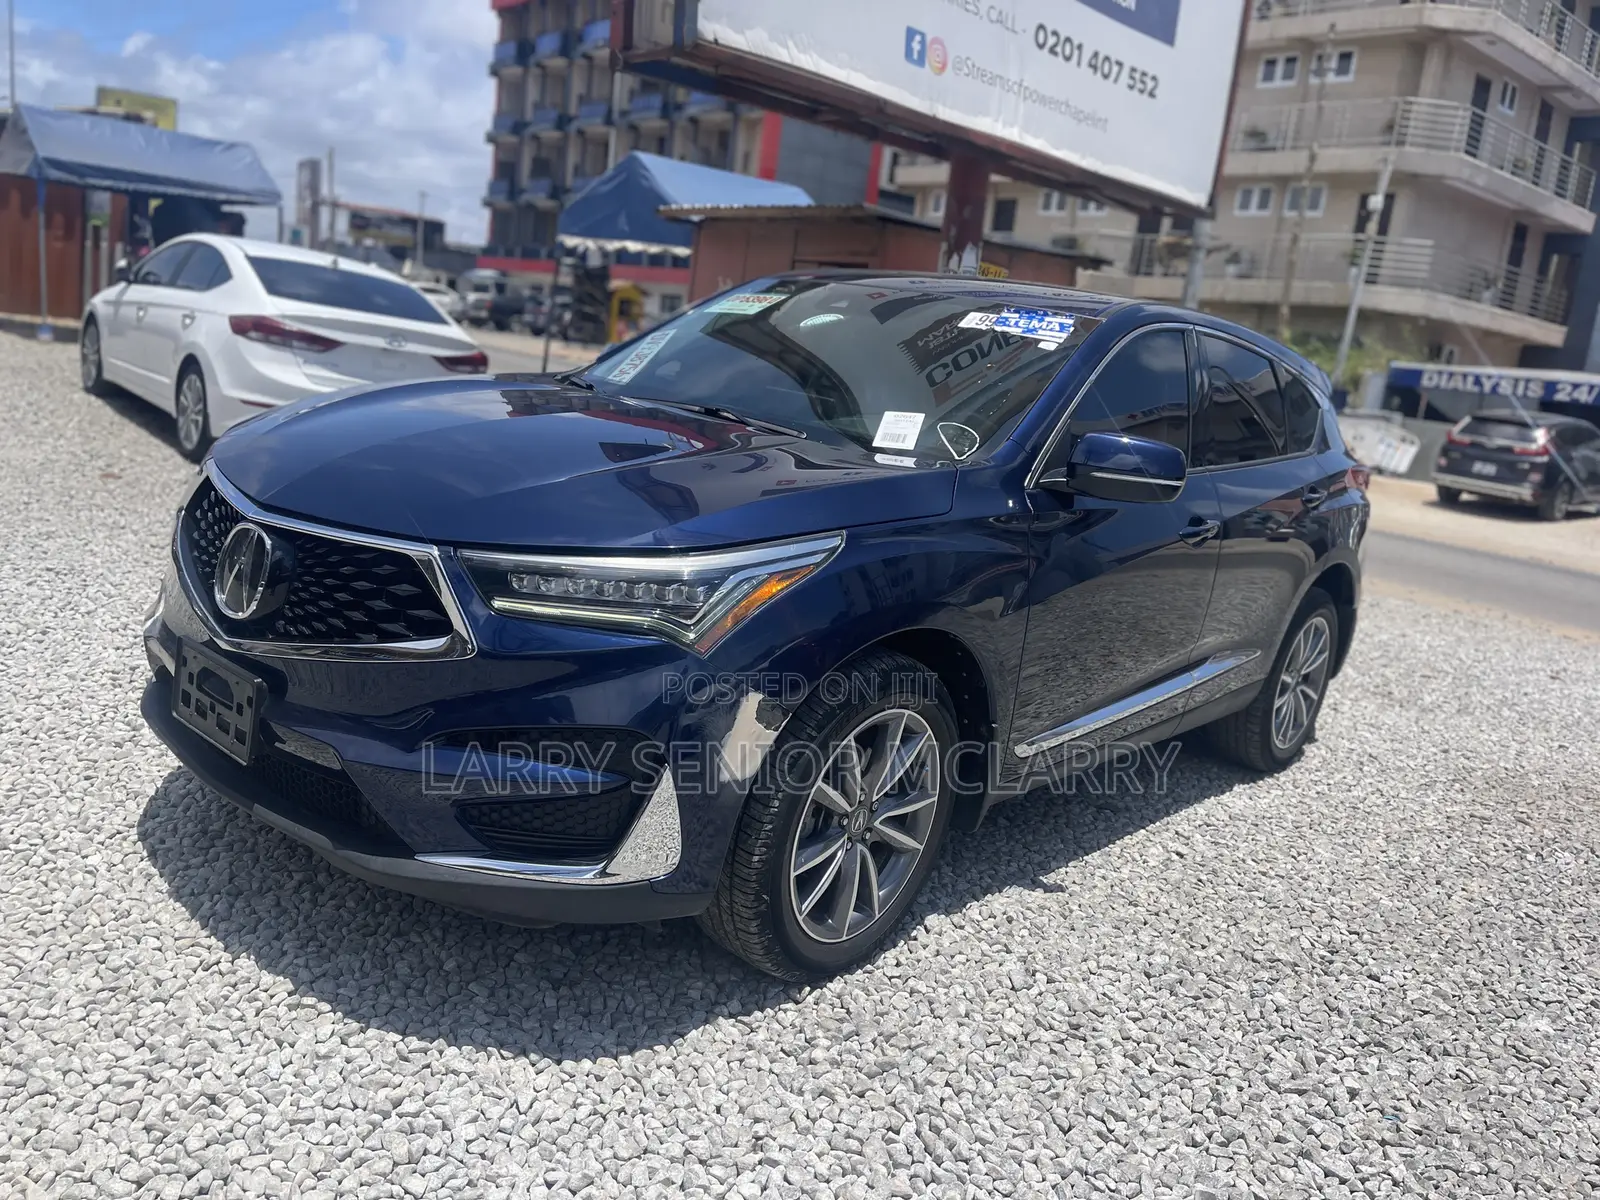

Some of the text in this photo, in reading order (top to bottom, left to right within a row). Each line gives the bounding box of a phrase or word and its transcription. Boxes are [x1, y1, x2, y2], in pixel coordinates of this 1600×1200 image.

[986, 5, 1019, 35] CALL
[1034, 23, 1084, 69] 0201
[1087, 49, 1124, 86] 407
[1128, 64, 1160, 99] 552
[1421, 370, 1545, 399] DIALYSIS
